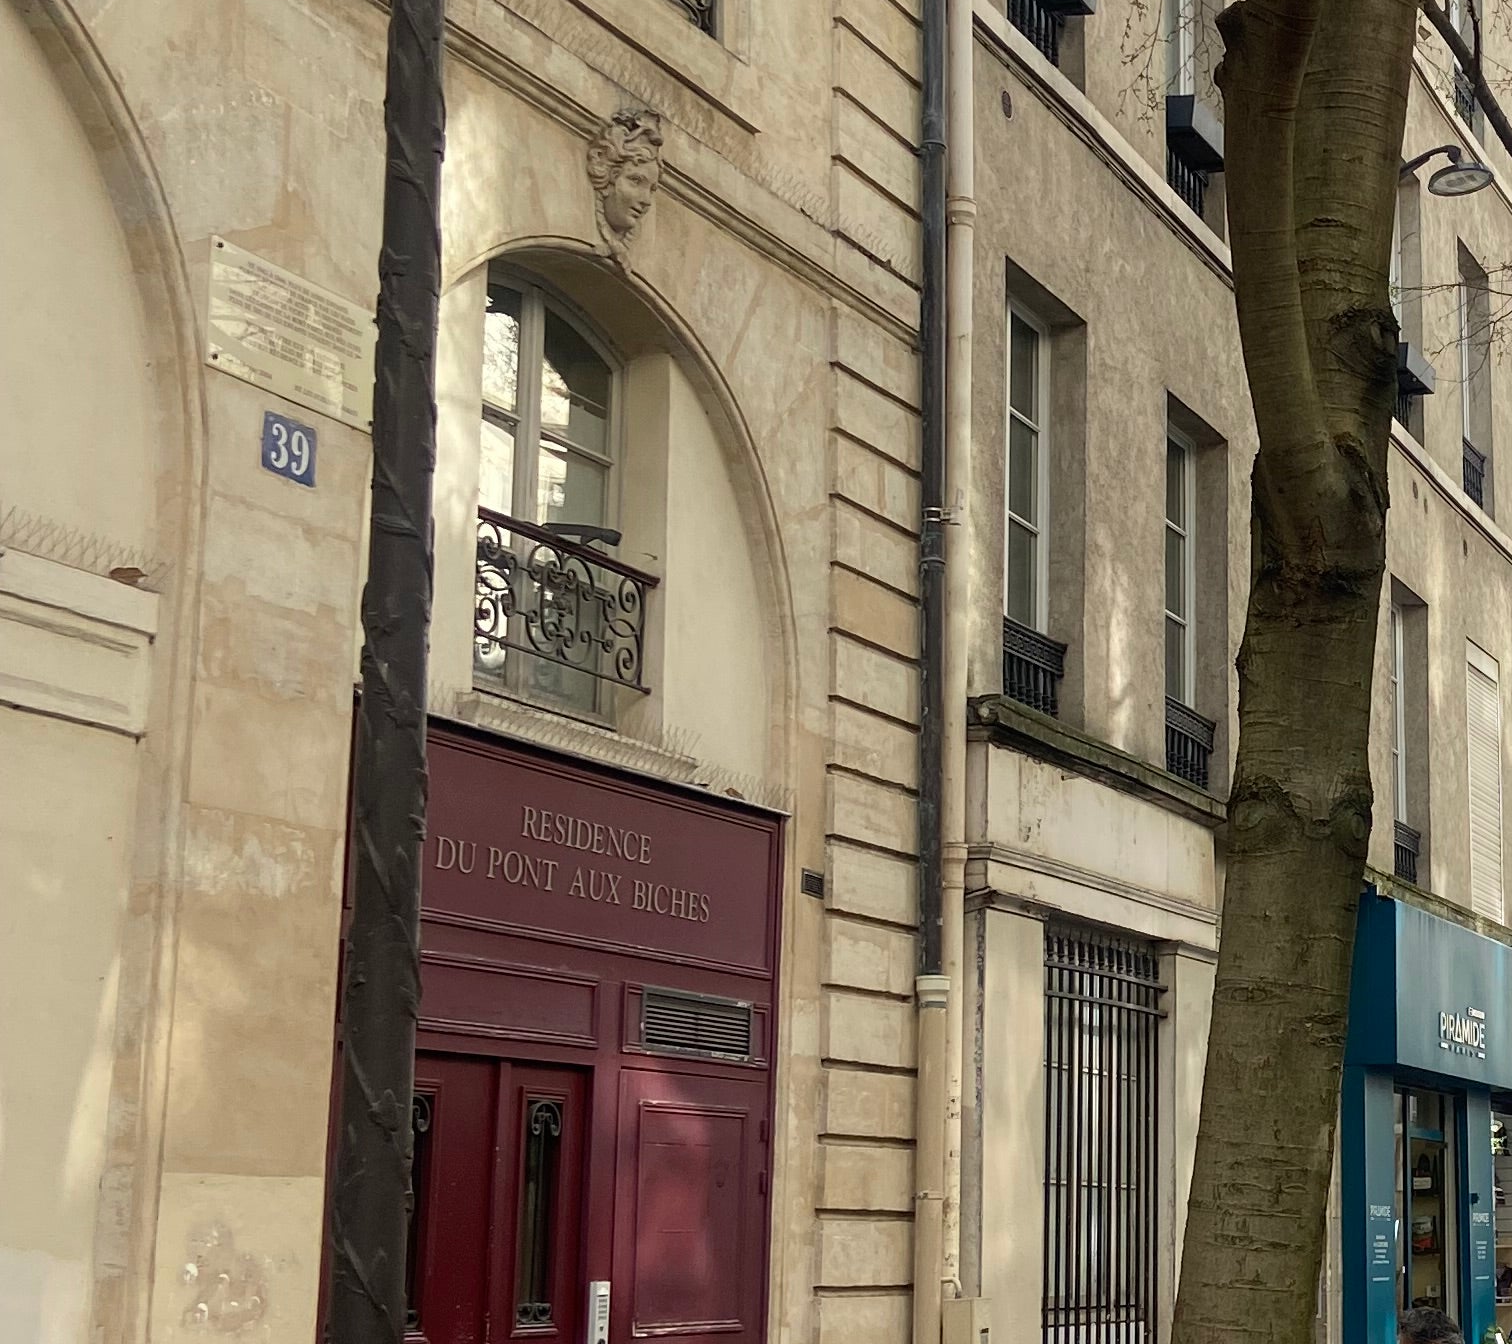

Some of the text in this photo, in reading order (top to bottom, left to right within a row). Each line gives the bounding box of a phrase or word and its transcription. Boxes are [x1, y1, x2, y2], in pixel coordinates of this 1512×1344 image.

[271, 422, 310, 476] 39
[521, 806, 652, 865] RESIDENCE
[435, 835, 711, 923] DU PONT AUX BICHES
